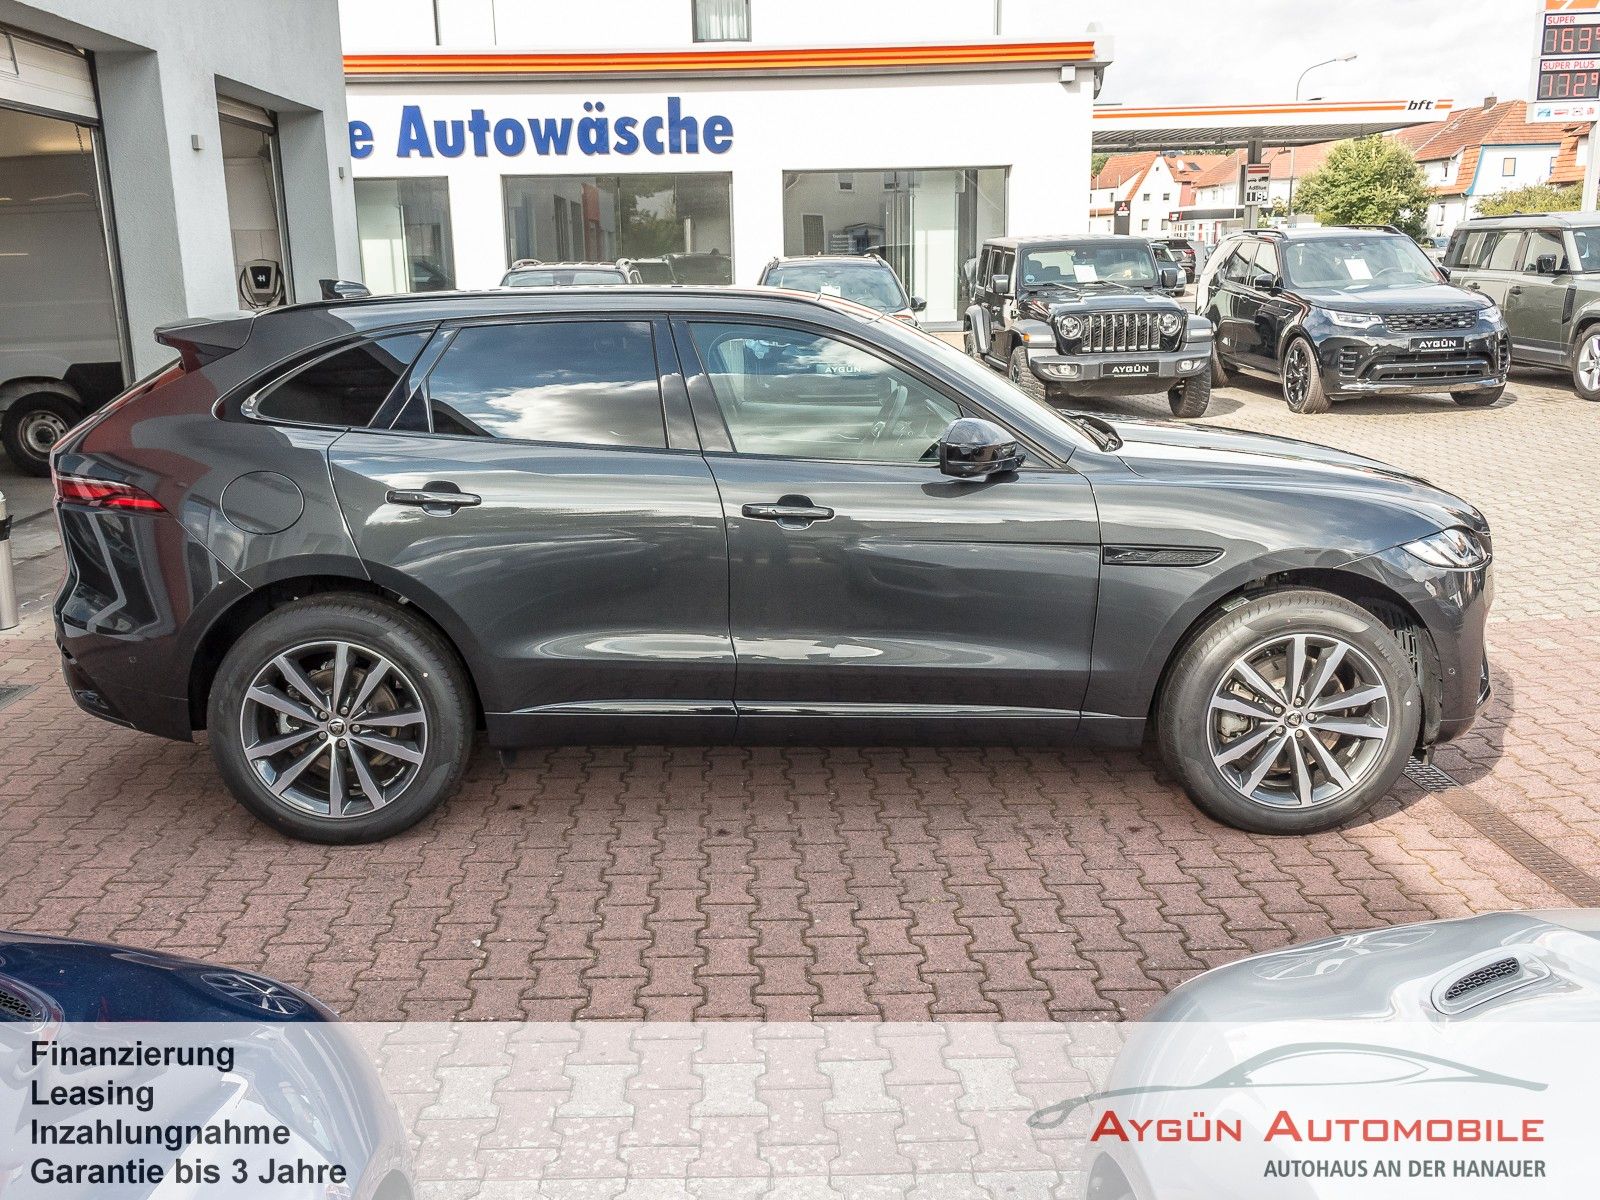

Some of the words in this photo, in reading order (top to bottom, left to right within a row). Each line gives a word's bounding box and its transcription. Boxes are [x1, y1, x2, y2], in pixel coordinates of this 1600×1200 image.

[1547, 16, 1576, 24] SUPER
[1543, 62, 1571, 70] SUPER
[1407, 99, 1434, 111] bft
[397, 97, 734, 157] Autowäsche
[1419, 339, 1456, 348] AYGÜN
[1111, 364, 1149, 373] AYGÜN
